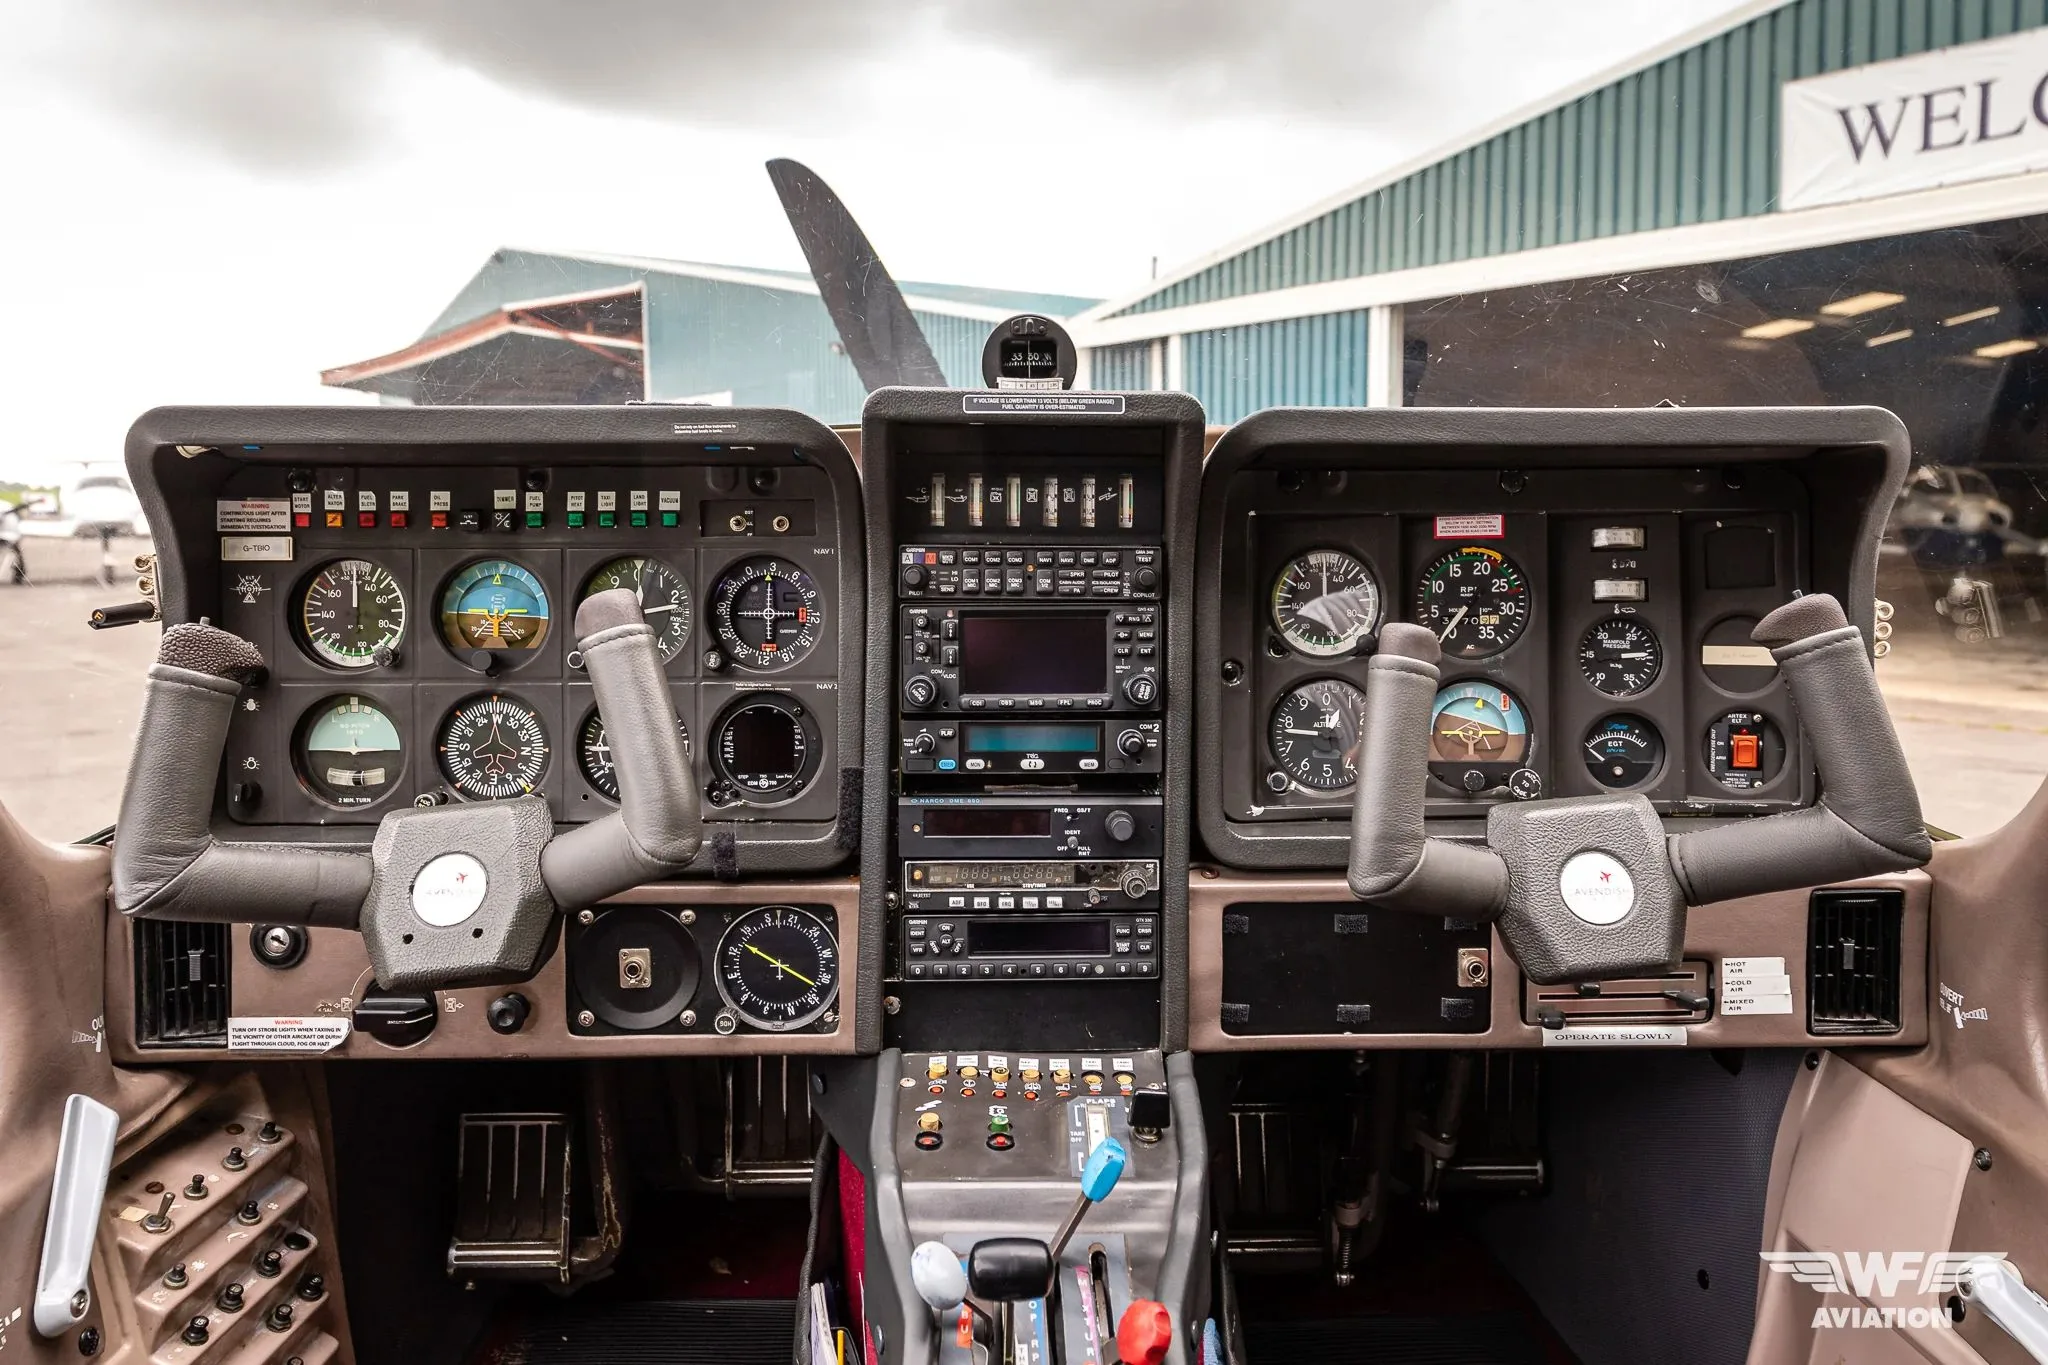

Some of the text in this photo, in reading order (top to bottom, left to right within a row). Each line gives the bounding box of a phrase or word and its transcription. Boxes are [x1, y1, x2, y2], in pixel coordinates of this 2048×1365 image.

[1450, 564, 1462, 577] 15
[1473, 562, 1491, 575] 20
[611, 576, 620, 588] 9
[1333, 575, 1345, 583] 40
[364, 584, 377, 592] 40
[1297, 582, 1311, 590] 160
[1432, 580, 1445, 593] 10
[1491, 579, 1508, 593] 25
[328, 590, 342, 598] 160
[376, 596, 388, 604] 60
[670, 590, 680, 603] 2
[1291, 602, 1305, 610] 140
[1431, 605, 1439, 618] 5
[1500, 602, 1515, 615] 30
[321, 611, 335, 619] 140
[378, 620, 390, 628] 80
[671, 622, 681, 636] 3
[1478, 626, 1495, 639] 35
[1626, 633, 1638, 641] 25
[1299, 698, 1309, 711] 9
[506, 719, 519, 729] 30
[1153, 724, 1160, 732] 2
[1285, 715, 1294, 729] 8
[1285, 741, 1294, 754] 7
[1300, 758, 1310, 771] 6
[1322, 764, 1332, 777] 5
[1345, 758, 1355, 771] 4
[1555, 1032, 1673, 1041] OPERATE SLOWLY
